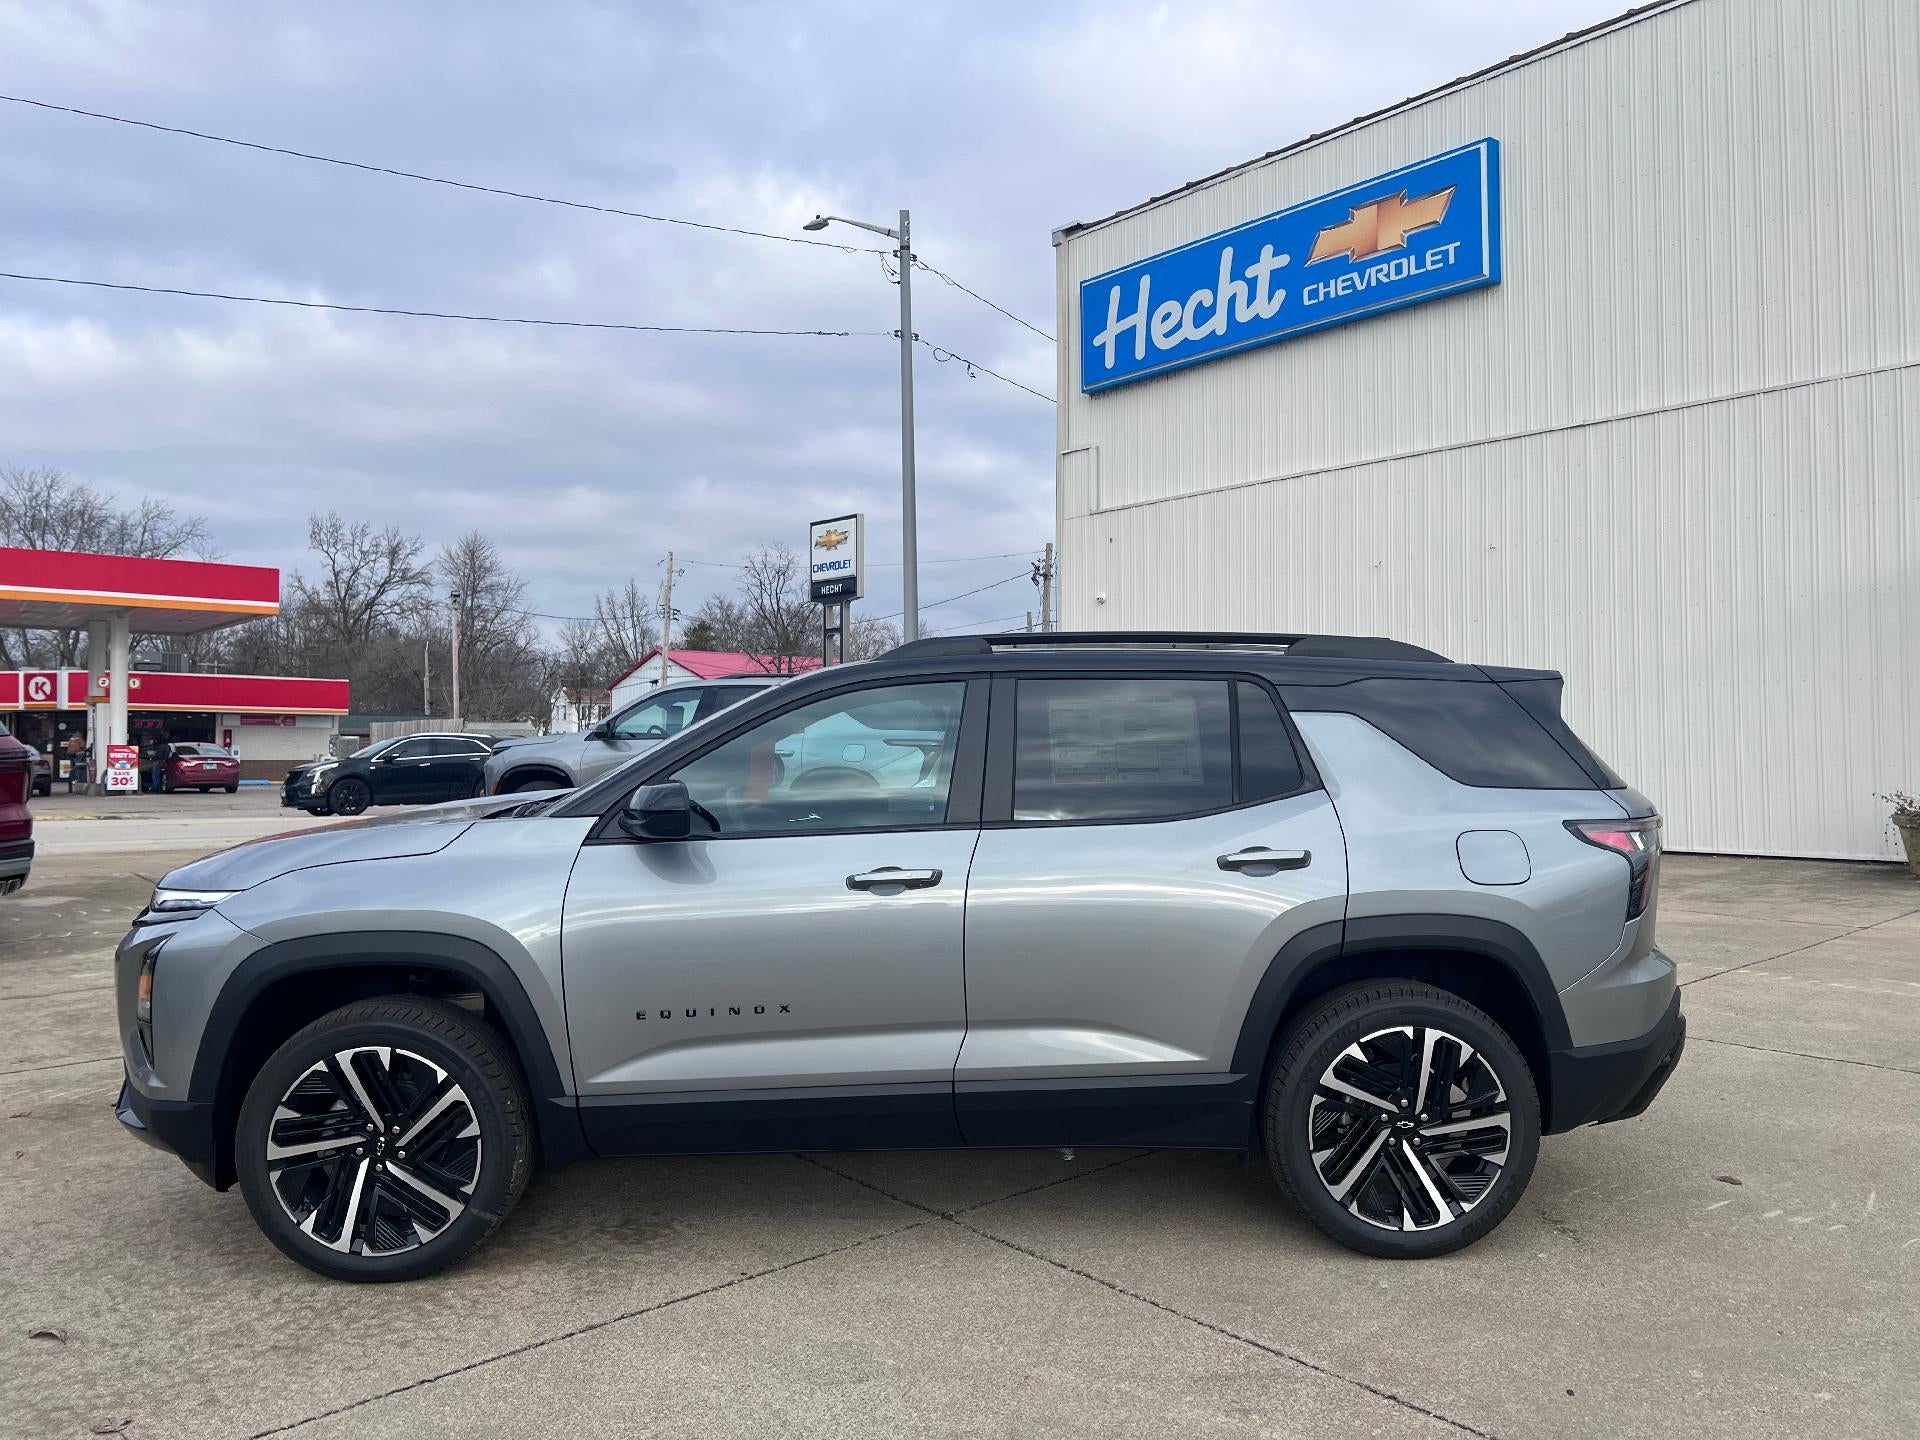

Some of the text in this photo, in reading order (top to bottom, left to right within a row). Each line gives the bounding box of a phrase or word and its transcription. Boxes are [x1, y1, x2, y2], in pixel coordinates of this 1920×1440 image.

[1302, 242, 1460, 305] CHEVROLET
[1093, 244, 1290, 369] Hecht
[813, 559, 851, 573] CHEVROLET
[821, 584, 843, 595] HECHT
[636, 1004, 791, 1020] EQUINOX
